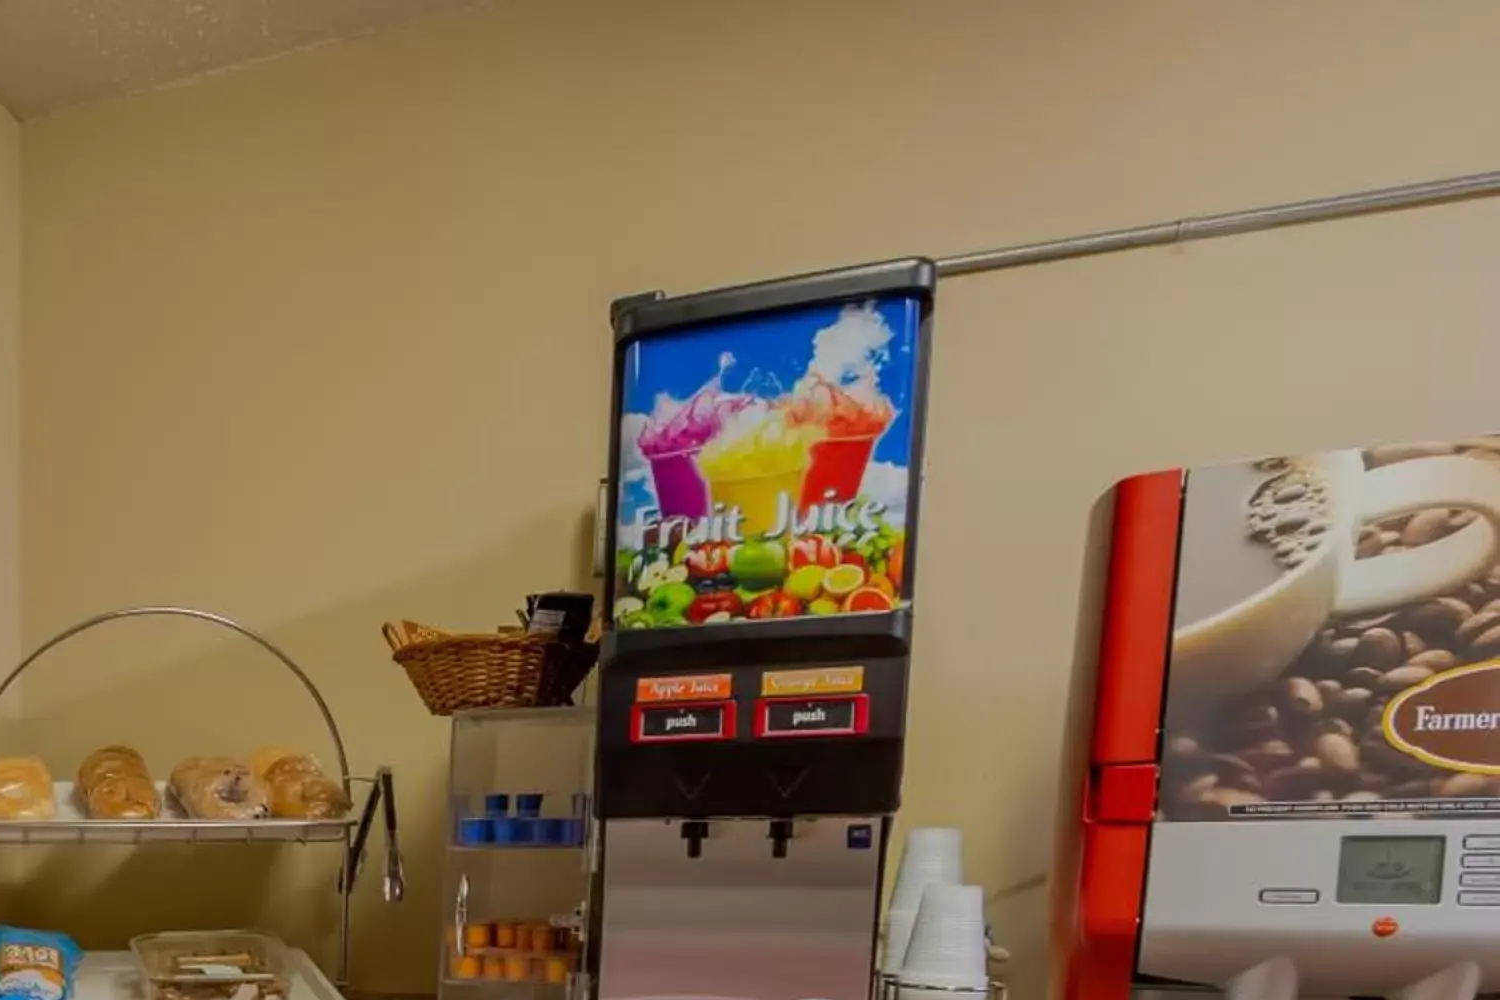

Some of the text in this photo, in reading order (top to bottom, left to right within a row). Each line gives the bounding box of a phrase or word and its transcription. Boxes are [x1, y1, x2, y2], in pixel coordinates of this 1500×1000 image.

[632, 488, 888, 552] Fruit Juice
[649, 680, 686, 699] Apple
[664, 713, 697, 731] push
[792, 709, 826, 727] push
